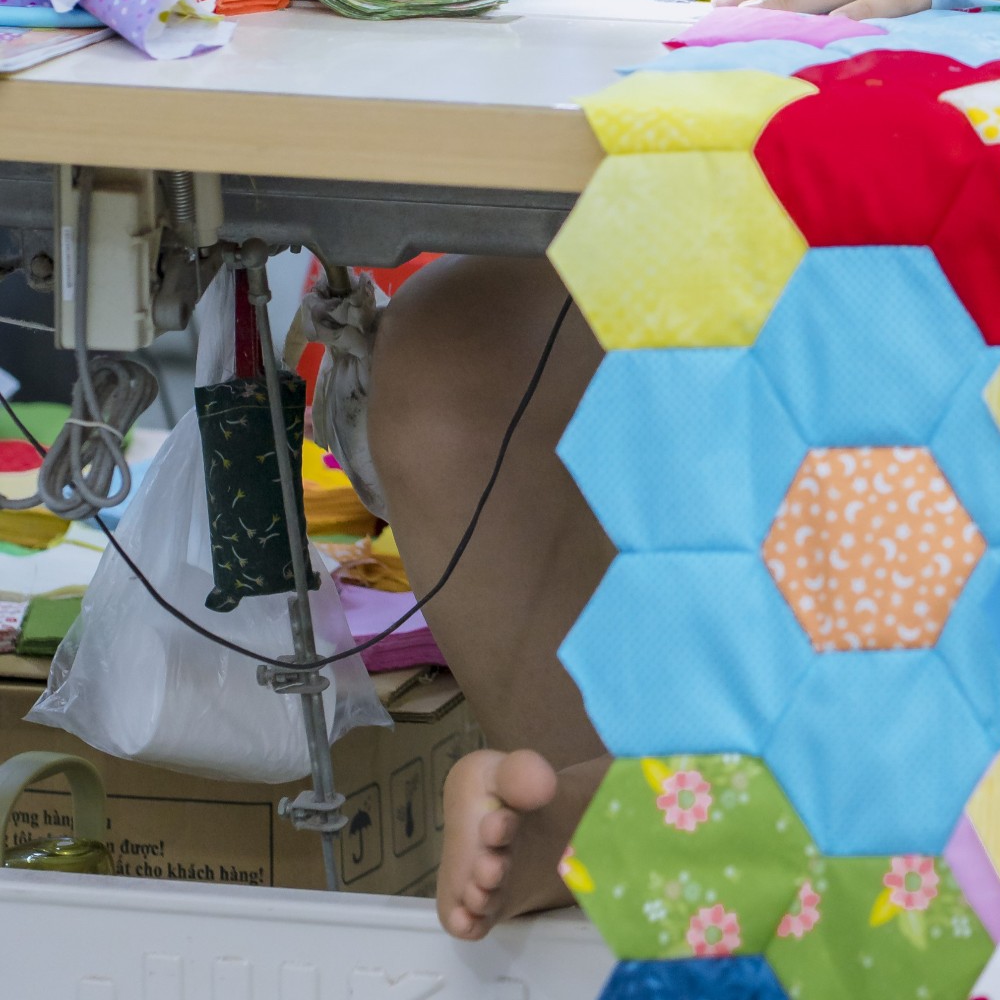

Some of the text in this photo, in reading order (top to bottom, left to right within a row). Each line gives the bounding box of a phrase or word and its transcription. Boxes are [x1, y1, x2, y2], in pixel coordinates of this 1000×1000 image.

[119, 838, 165, 860] được!
[135, 861, 162, 878] cho
[167, 862, 215, 881] khách
[219, 865, 264, 886] hàng!
